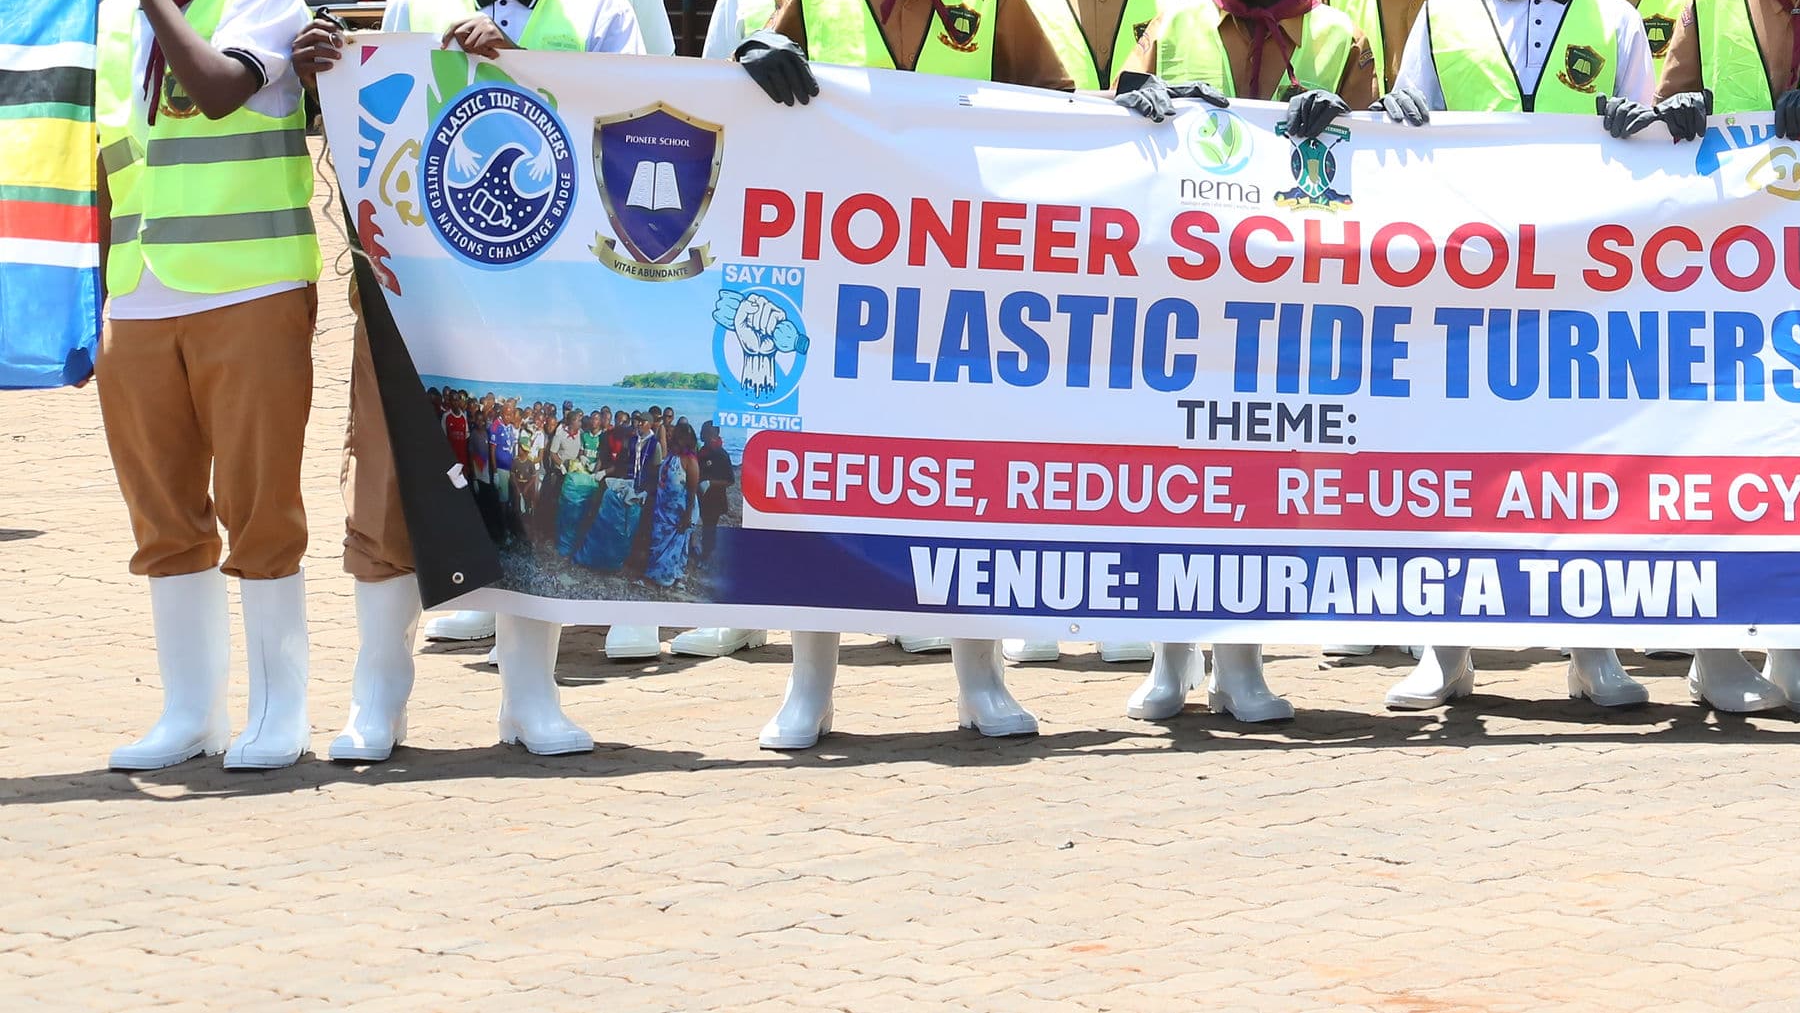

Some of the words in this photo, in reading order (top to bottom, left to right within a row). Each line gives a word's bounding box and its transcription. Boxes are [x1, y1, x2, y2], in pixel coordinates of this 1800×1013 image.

[437, 94, 486, 146] PLASTIC
[488, 92, 520, 111] TIDE
[523, 100, 569, 161] TURNERS
[625, 134, 657, 145] PIONEER
[659, 137, 690, 147] SCHOOL
[427, 155, 443, 209] UNITED
[438, 212, 484, 256] NATIONS
[488, 218, 555, 259] CHALLENGE
[552, 172, 571, 217] BADGE
[1180, 178, 1260, 204] nema
[740, 187, 1141, 279] PIONEER
[1166, 210, 1557, 290] SCHOOL
[614, 259, 637, 275] VITAE
[638, 266, 689, 278] ABUNDANTE
[725, 265, 766, 284] SAY
[771, 268, 802, 286] NO
[833, 284, 1199, 393] PLASTIC
[1224, 301, 1413, 398] TIDE
[718, 412, 738, 426] TO
[741, 413, 801, 430] PLASTIC
[1177, 399, 1358, 446] THEME:
[765, 448, 989, 517] REFUSE,
[1006, 462, 1247, 522] REDUCE,
[1277, 468, 1474, 520] RE-USE
[1497, 473, 1619, 521] AND
[909, 545, 1140, 612] VENUE:
[1156, 553, 1506, 618] MURANG'A
[1519, 558, 1718, 620] TOWN
